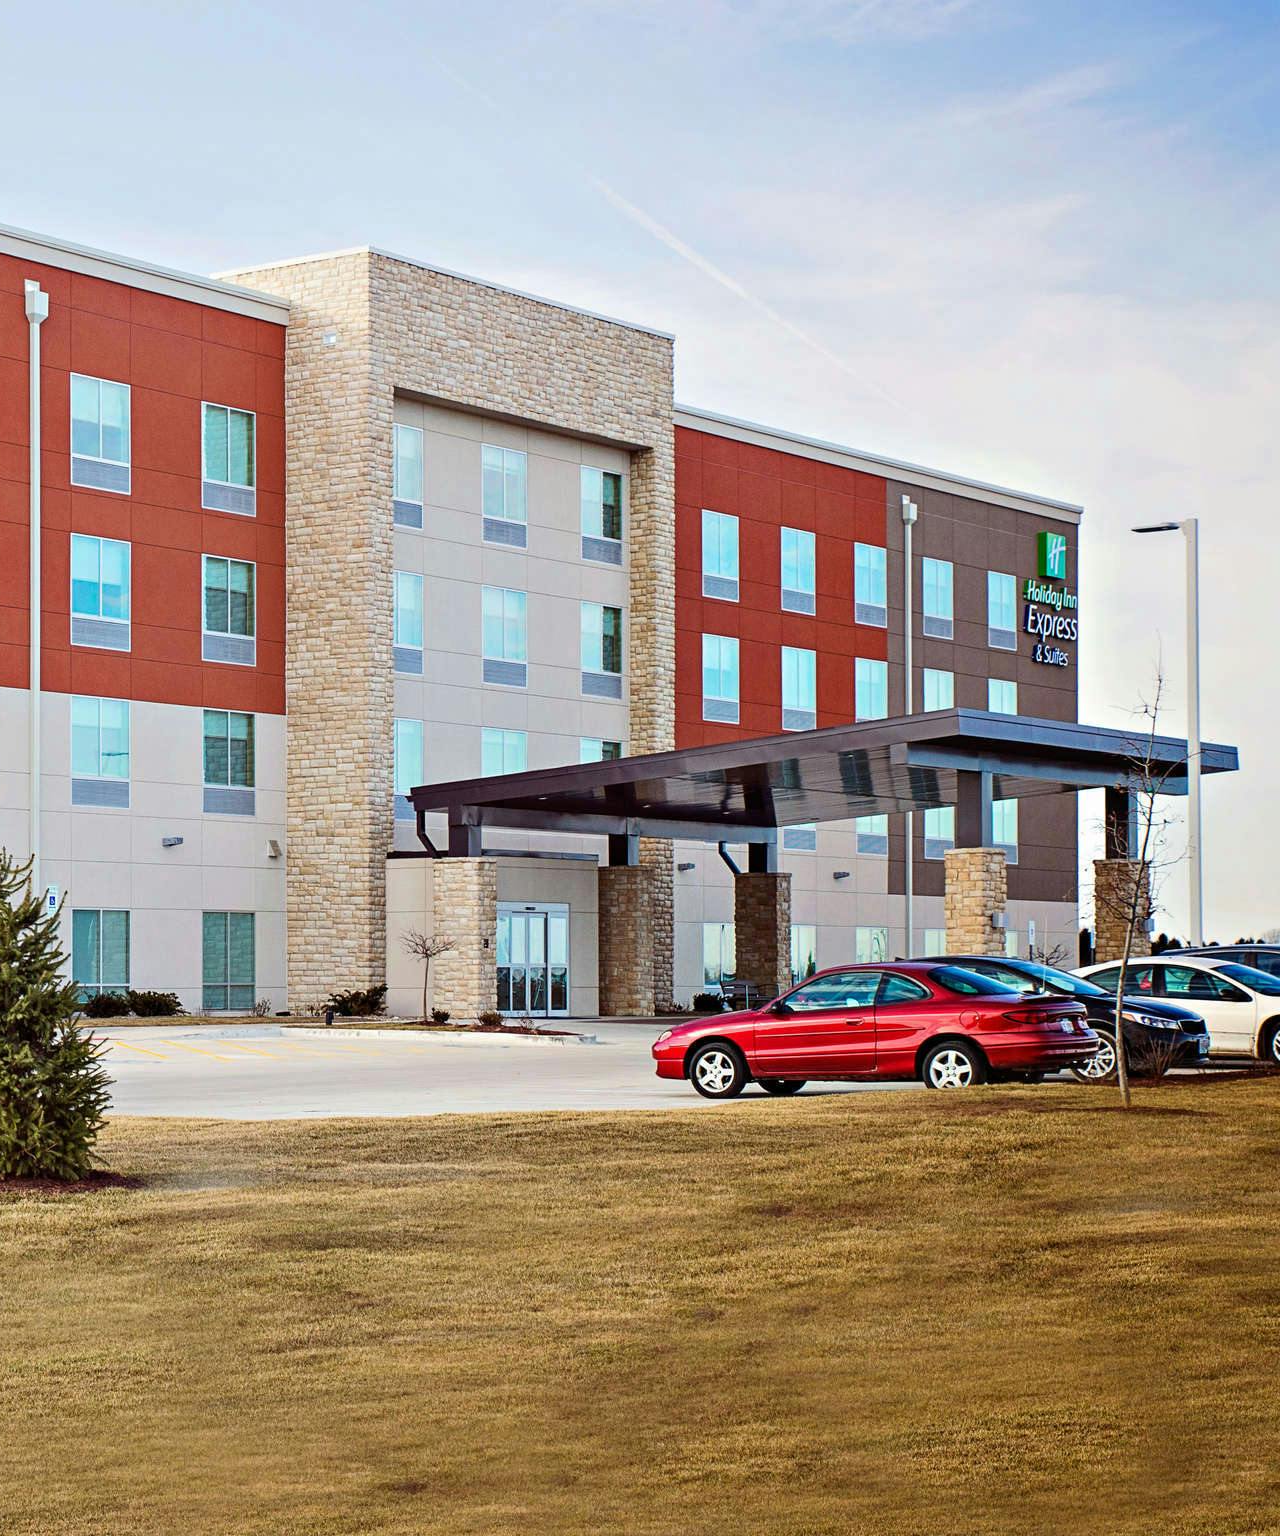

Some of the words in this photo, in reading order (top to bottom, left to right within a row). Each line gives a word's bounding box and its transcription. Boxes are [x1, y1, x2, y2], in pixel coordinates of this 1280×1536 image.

[1027, 580, 1063, 611] Holiday
[1063, 586, 1077, 609] Inn
[1027, 604, 1078, 642] Express
[1036, 644, 1043, 662] &
[1044, 645, 1069, 667] Suites
